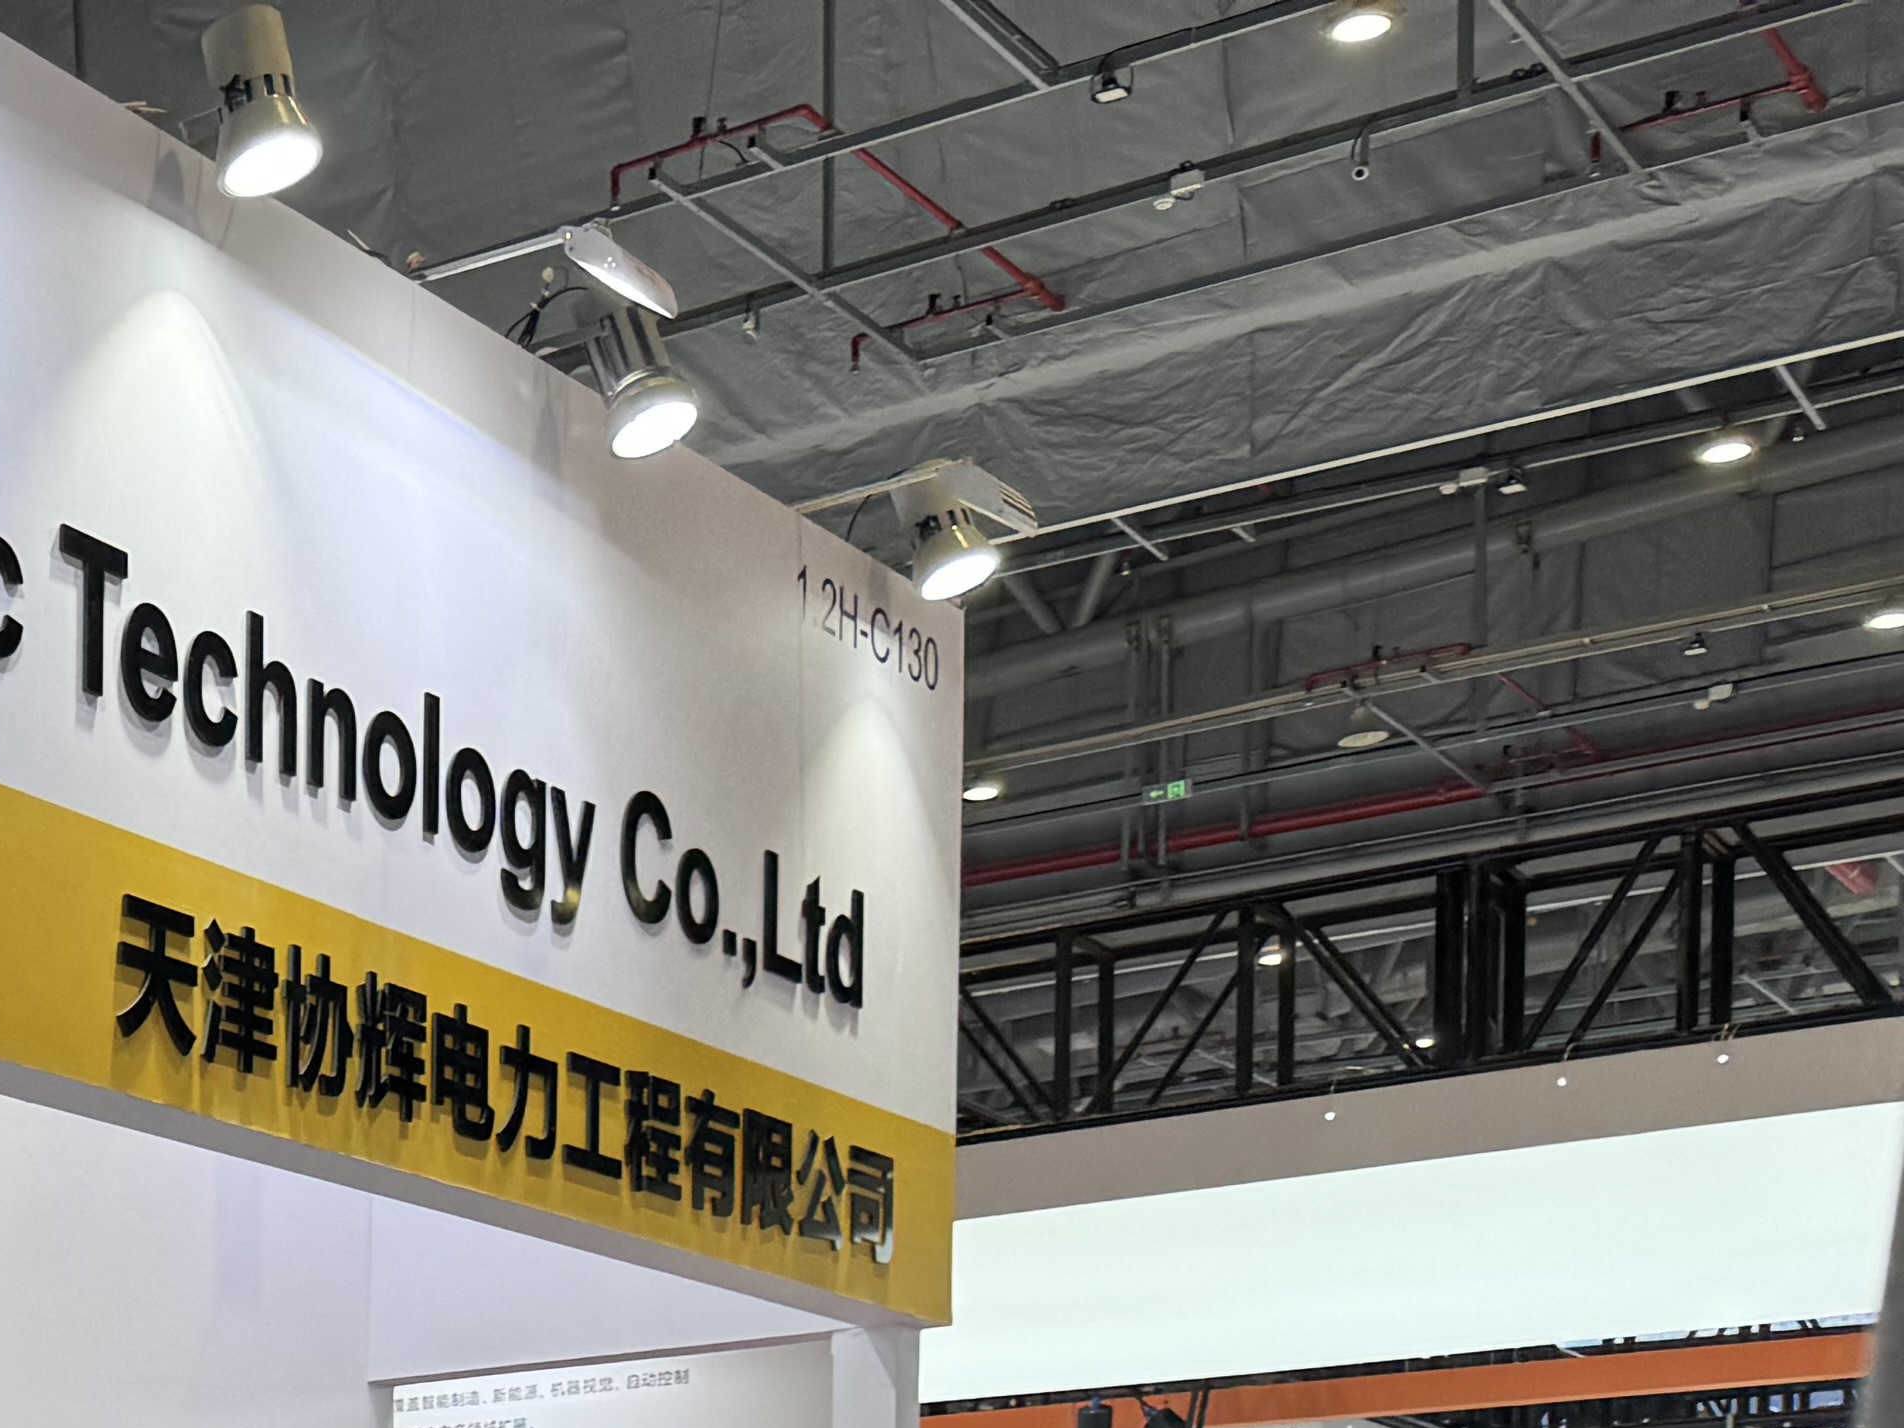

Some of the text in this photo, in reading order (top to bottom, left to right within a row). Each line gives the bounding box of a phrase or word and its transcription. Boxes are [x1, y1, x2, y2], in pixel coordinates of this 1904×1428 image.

[58, 523, 595, 925] Technology
[621, 790, 865, 1009] Co.,Ltd
[115, 893, 895, 1264] 天津协辉电力工程有限公司
